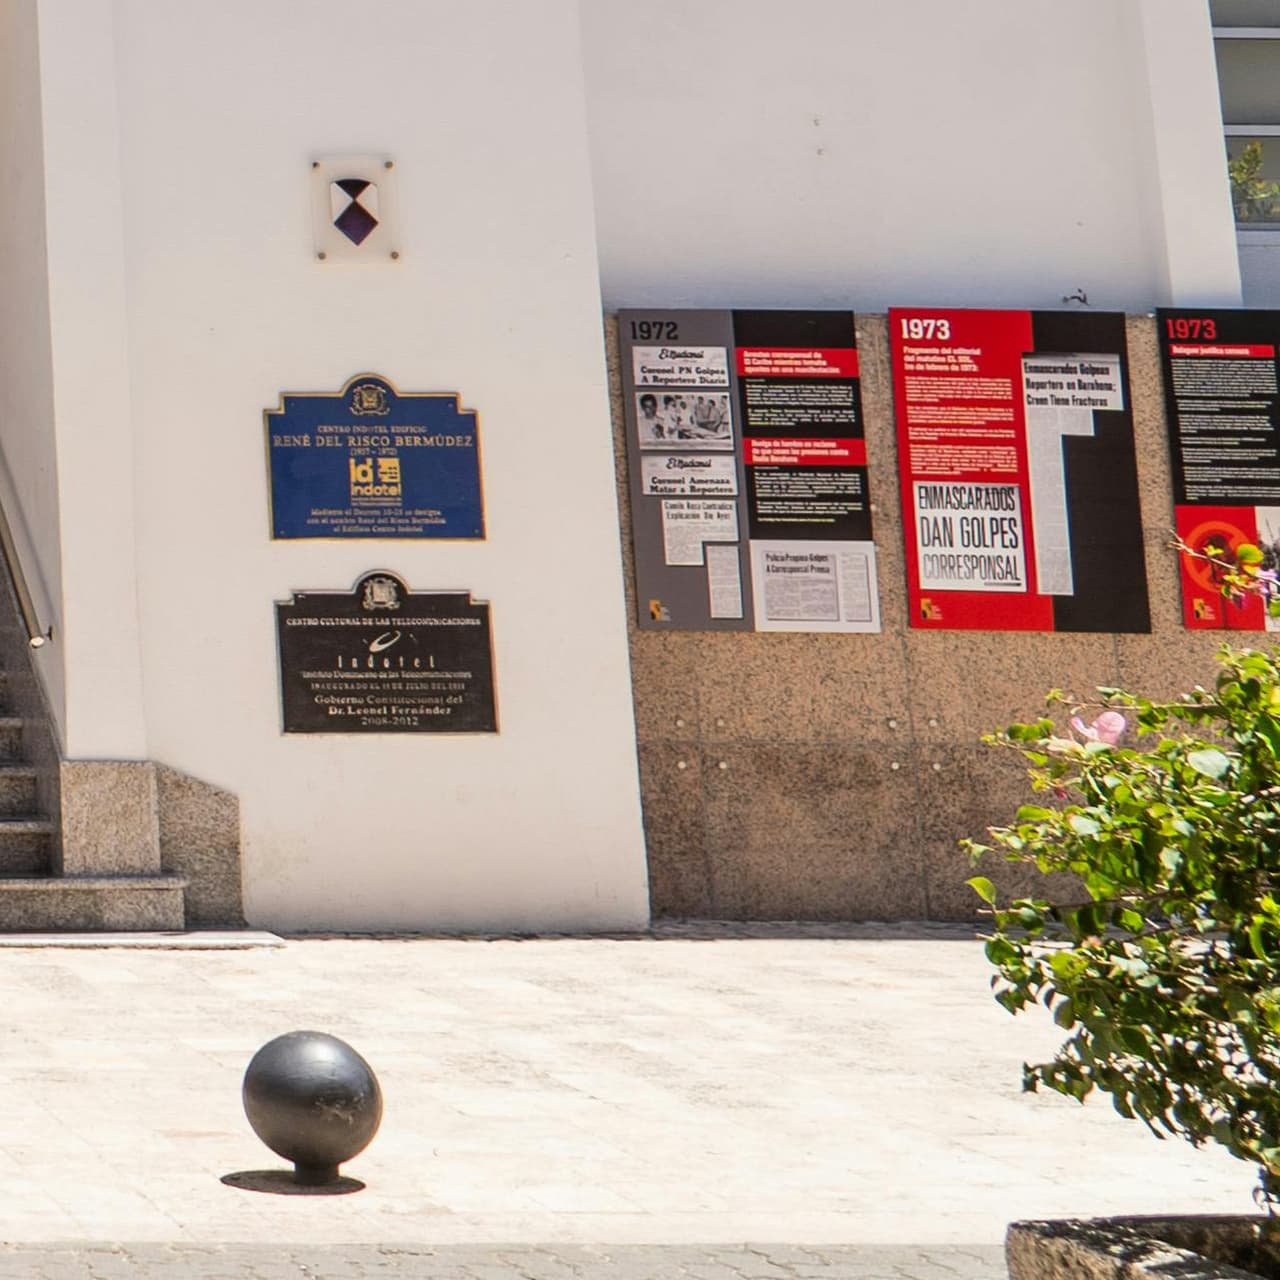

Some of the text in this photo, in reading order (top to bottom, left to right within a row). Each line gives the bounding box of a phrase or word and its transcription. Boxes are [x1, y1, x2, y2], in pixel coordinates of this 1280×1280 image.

[630, 321, 679, 340] 1972
[901, 318, 950, 339] 1973
[1167, 319, 1216, 339] 1973
[273, 433, 473, 447] RENÉ DEL RISCO BERMÚDEZ
[918, 485, 1015, 511] ENMASCARADOS
[920, 516, 1018, 549] DAN GOLPES
[923, 553, 1021, 581] CORRESPONSAL
[314, 695, 364, 704] Gobierno
[446, 695, 463, 704] del
[328, 705, 451, 715] Dr. Leonel Fernández
